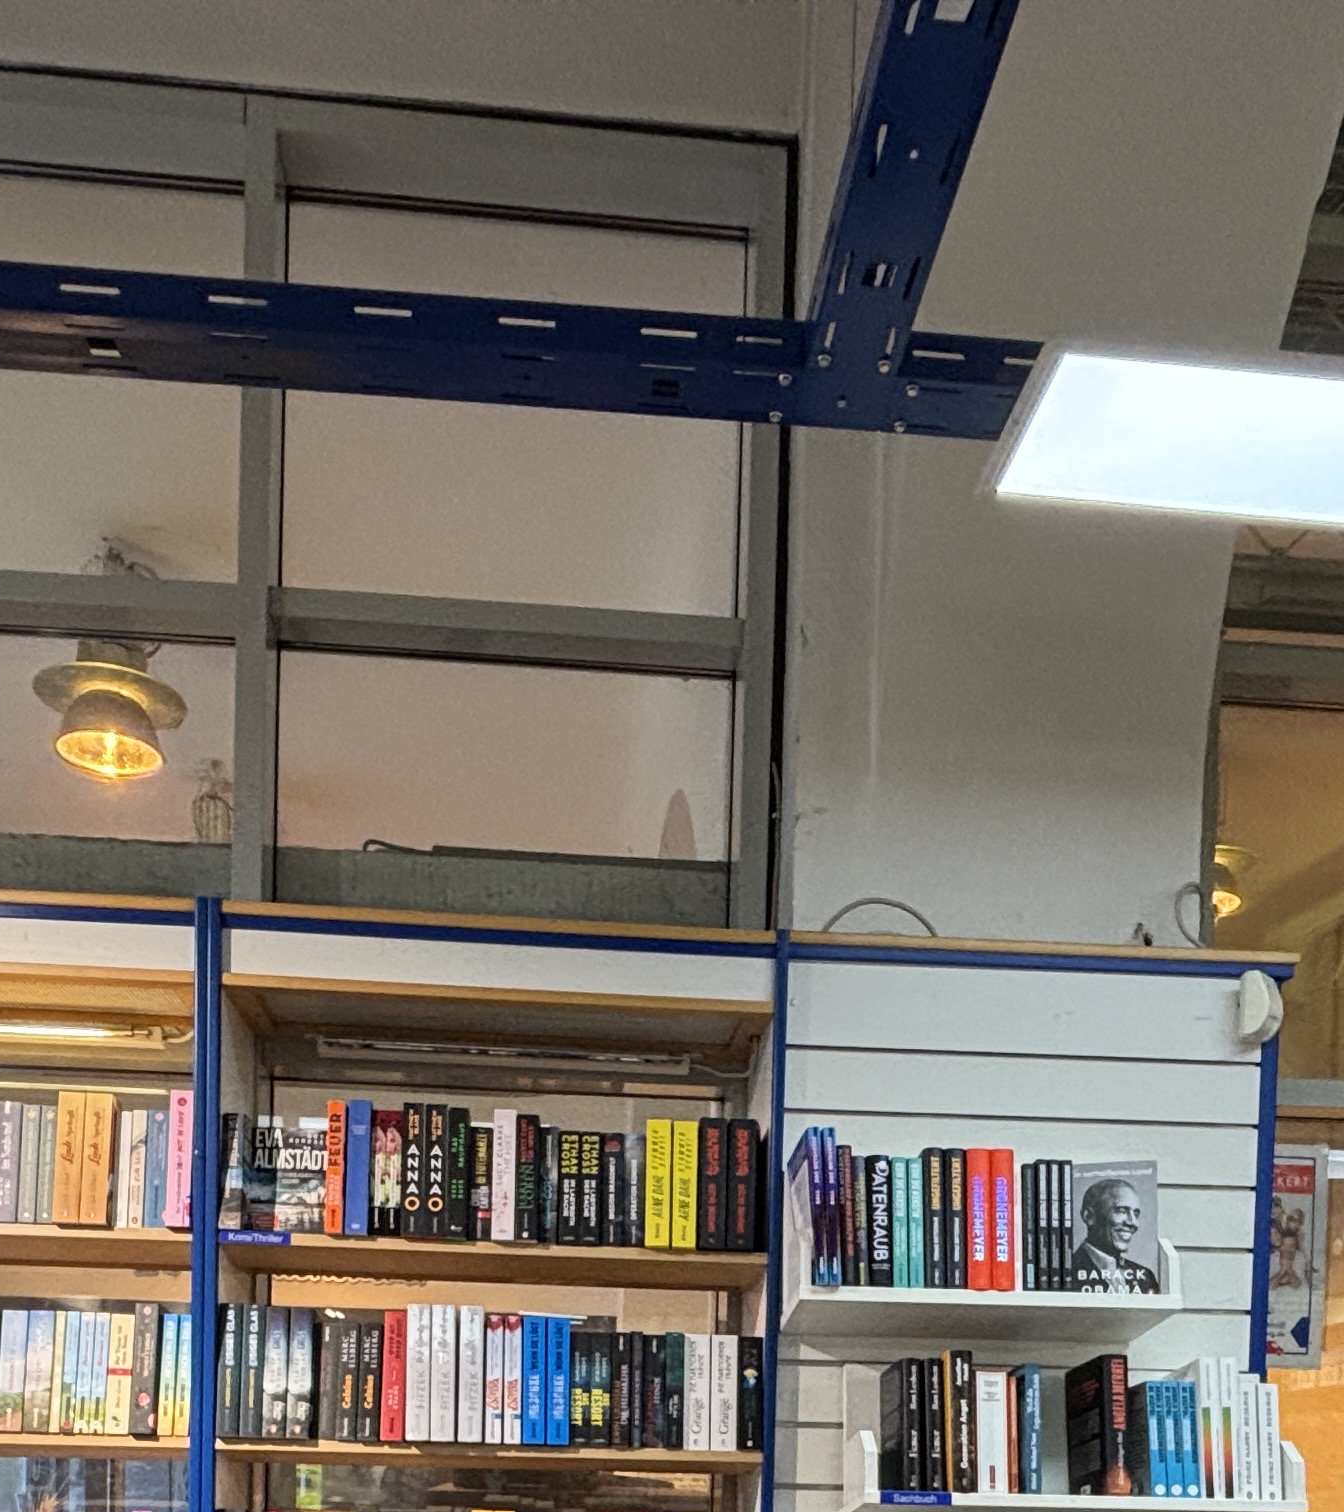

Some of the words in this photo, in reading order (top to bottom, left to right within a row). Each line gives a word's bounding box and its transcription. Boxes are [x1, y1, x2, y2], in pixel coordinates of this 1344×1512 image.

[256, 1128, 283, 1148] EVA
[329, 1114, 341, 1166] FEUER
[561, 1135, 570, 1174] CROSS
[569, 1135, 579, 1174] ETHAN
[581, 1136, 590, 1174] CROSS
[590, 1136, 599, 1174] ETHAN
[256, 1146, 328, 1171] ALMSTÄDT
[406, 1144, 420, 1194] ANNA
[430, 1144, 443, 1195] ANNA
[1274, 1174, 1309, 1188] KERT
[652, 1198, 664, 1219] ARNE
[678, 1200, 690, 1221] ARNE
[1077, 1268, 1146, 1281] BARACK
[1081, 1284, 1142, 1295] OBAMA
[225, 1309, 236, 1331] GLAS
[249, 1310, 259, 1332] GLAS
[1111, 1359, 1125, 1393] MERKEL
[1112, 1393, 1126, 1430] ANGELA
[960, 1424, 969, 1468] Generation
